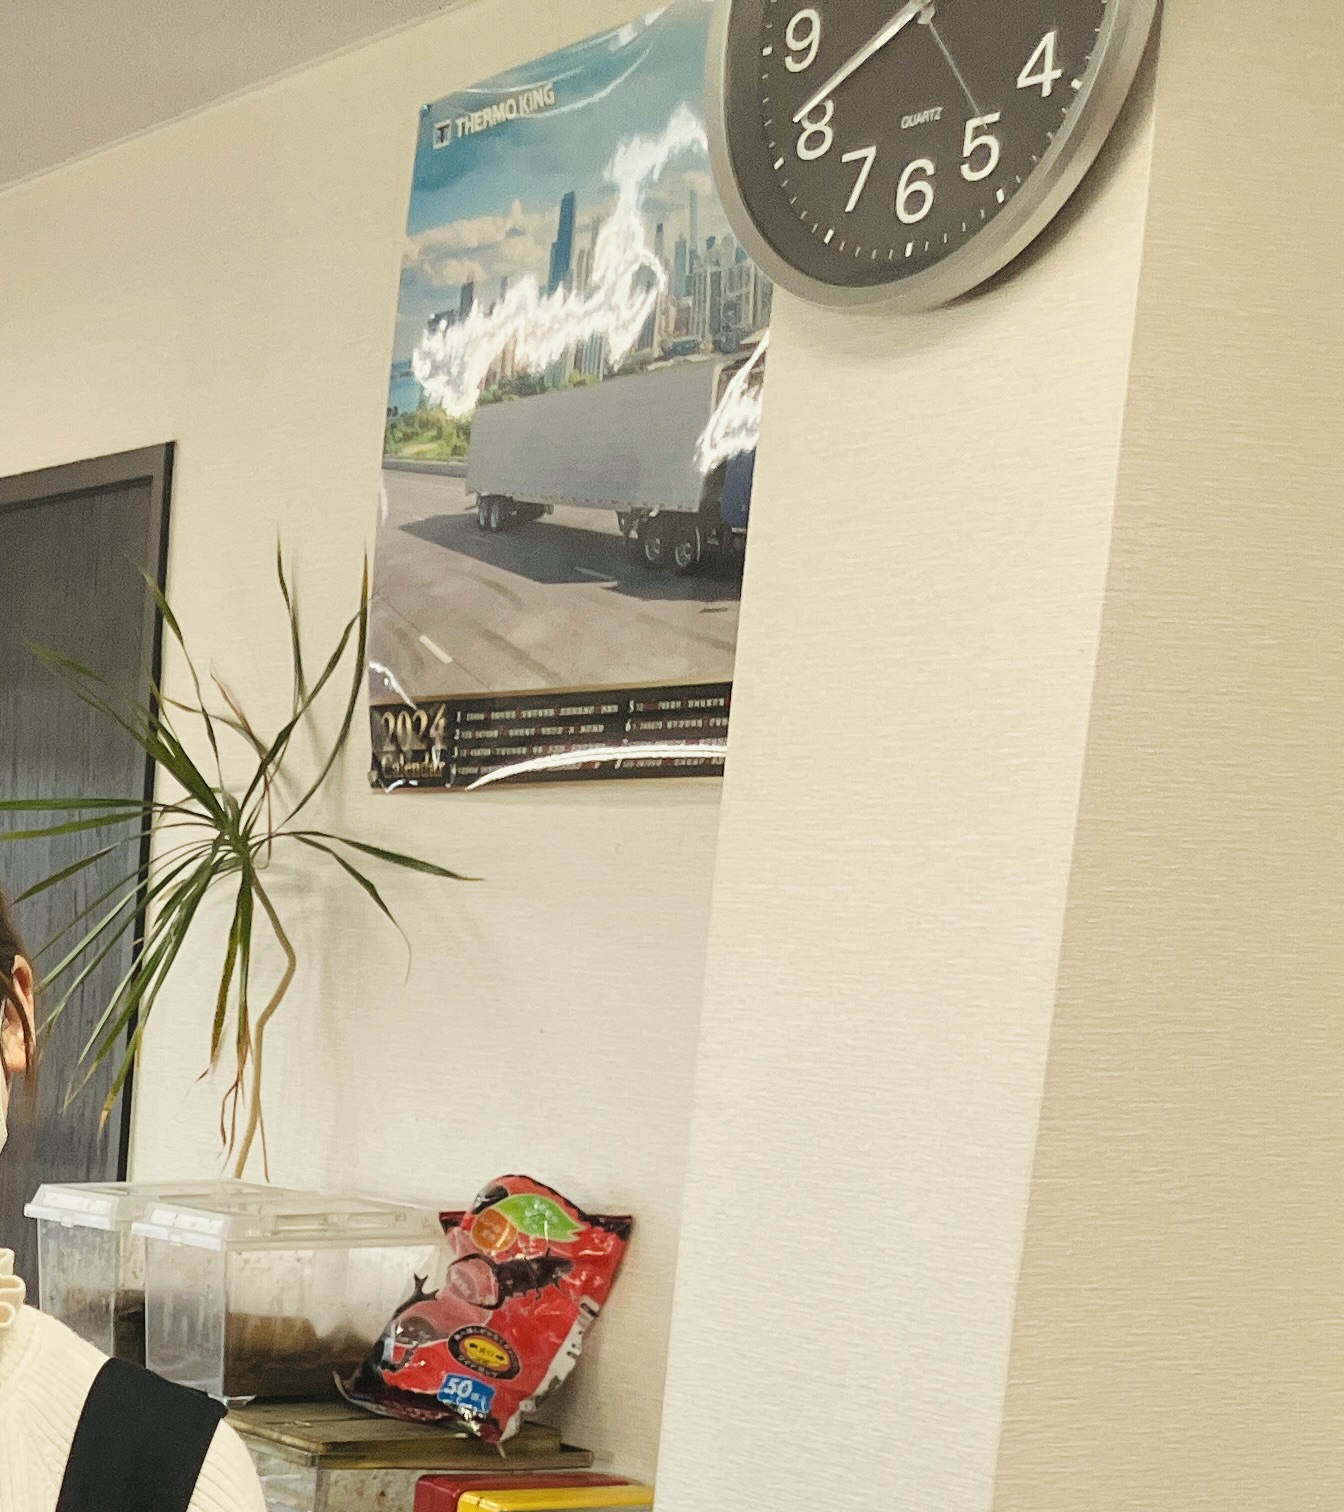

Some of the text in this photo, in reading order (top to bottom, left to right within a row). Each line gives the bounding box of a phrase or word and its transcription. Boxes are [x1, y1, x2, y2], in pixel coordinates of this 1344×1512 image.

[784, 8, 822, 73] 9
[1017, 30, 1063, 98] 4
[455, 98, 517, 139] THERMO
[518, 80, 555, 117] KING
[796, 98, 835, 163] 8
[900, 107, 944, 129] QUARTZ
[841, 145, 877, 214] 7
[960, 111, 1001, 183] 5
[895, 159, 936, 225] 6
[381, 703, 448, 752] 2024
